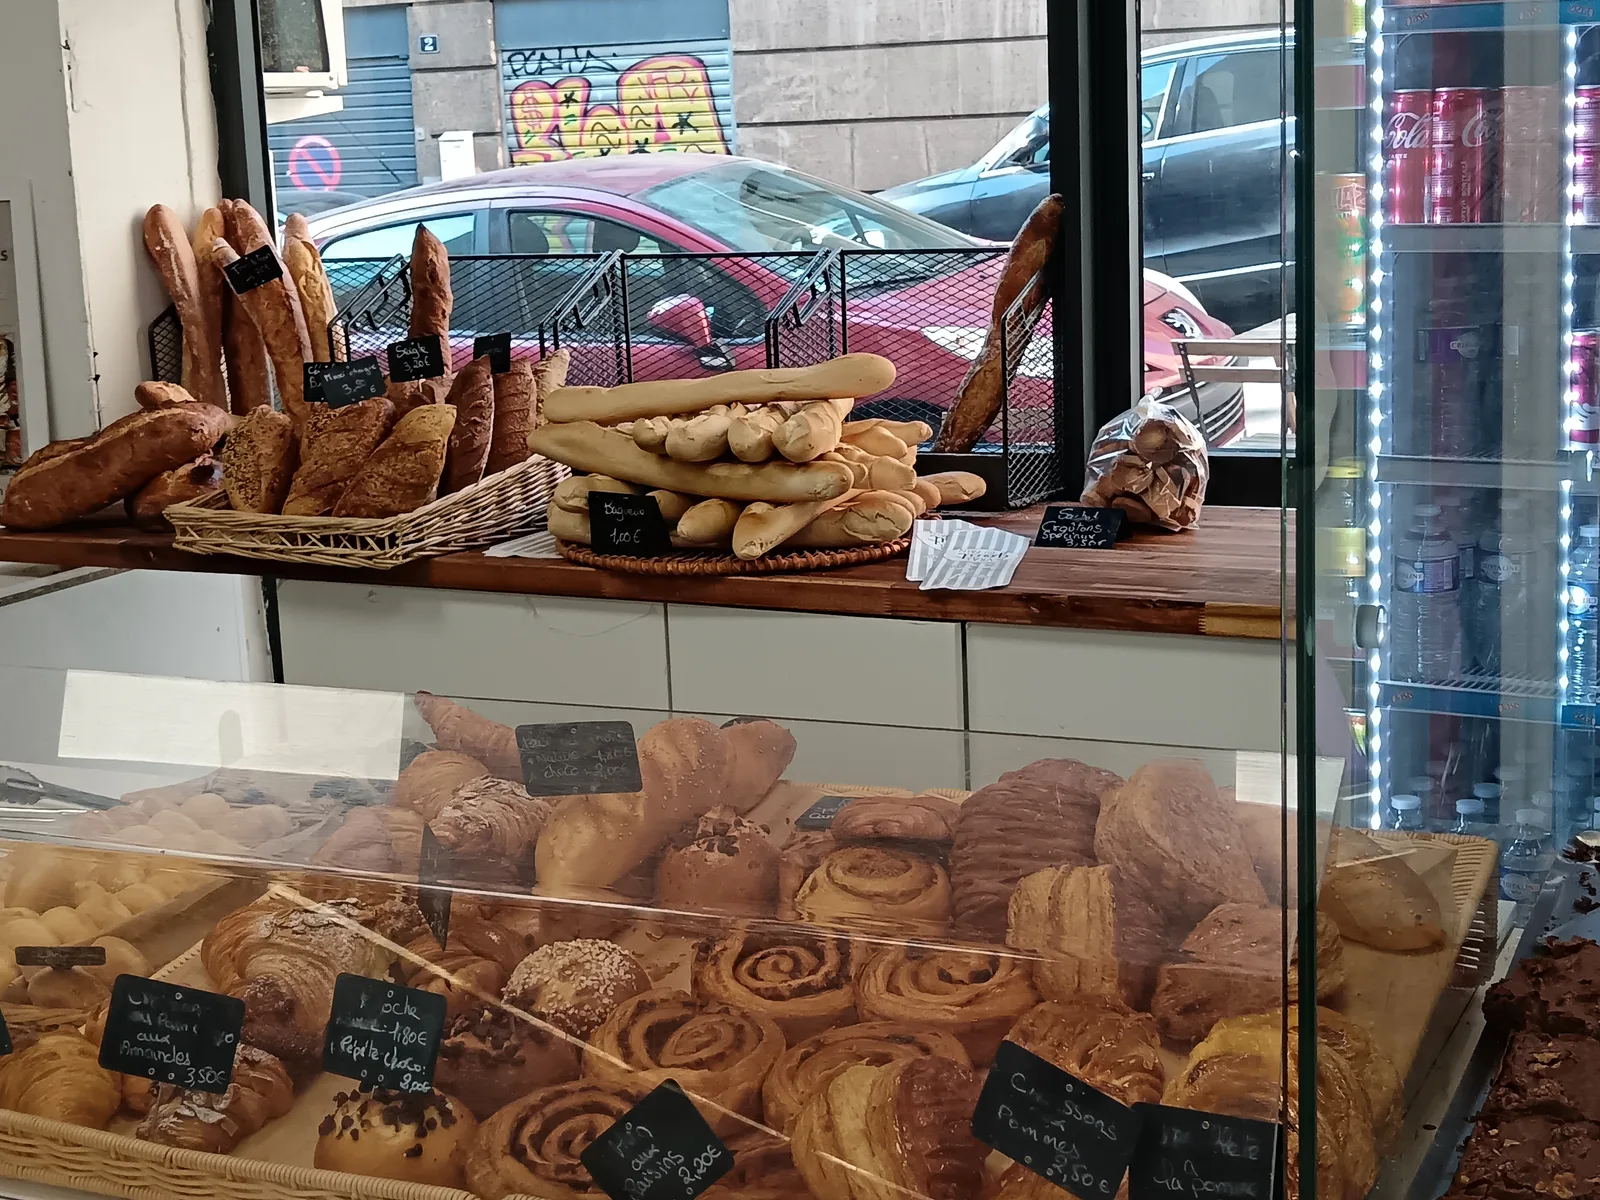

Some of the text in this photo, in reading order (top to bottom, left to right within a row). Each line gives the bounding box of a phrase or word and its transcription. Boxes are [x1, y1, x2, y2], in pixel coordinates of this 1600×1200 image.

[424, 38, 434, 51] 2
[395, 343, 429, 359] Seigle
[403, 356, 430, 373] 3,20€
[609, 527, 641, 545] 1,00€
[136, 1032, 171, 1045] aux
[389, 1021, 427, 1046] 1,80€
